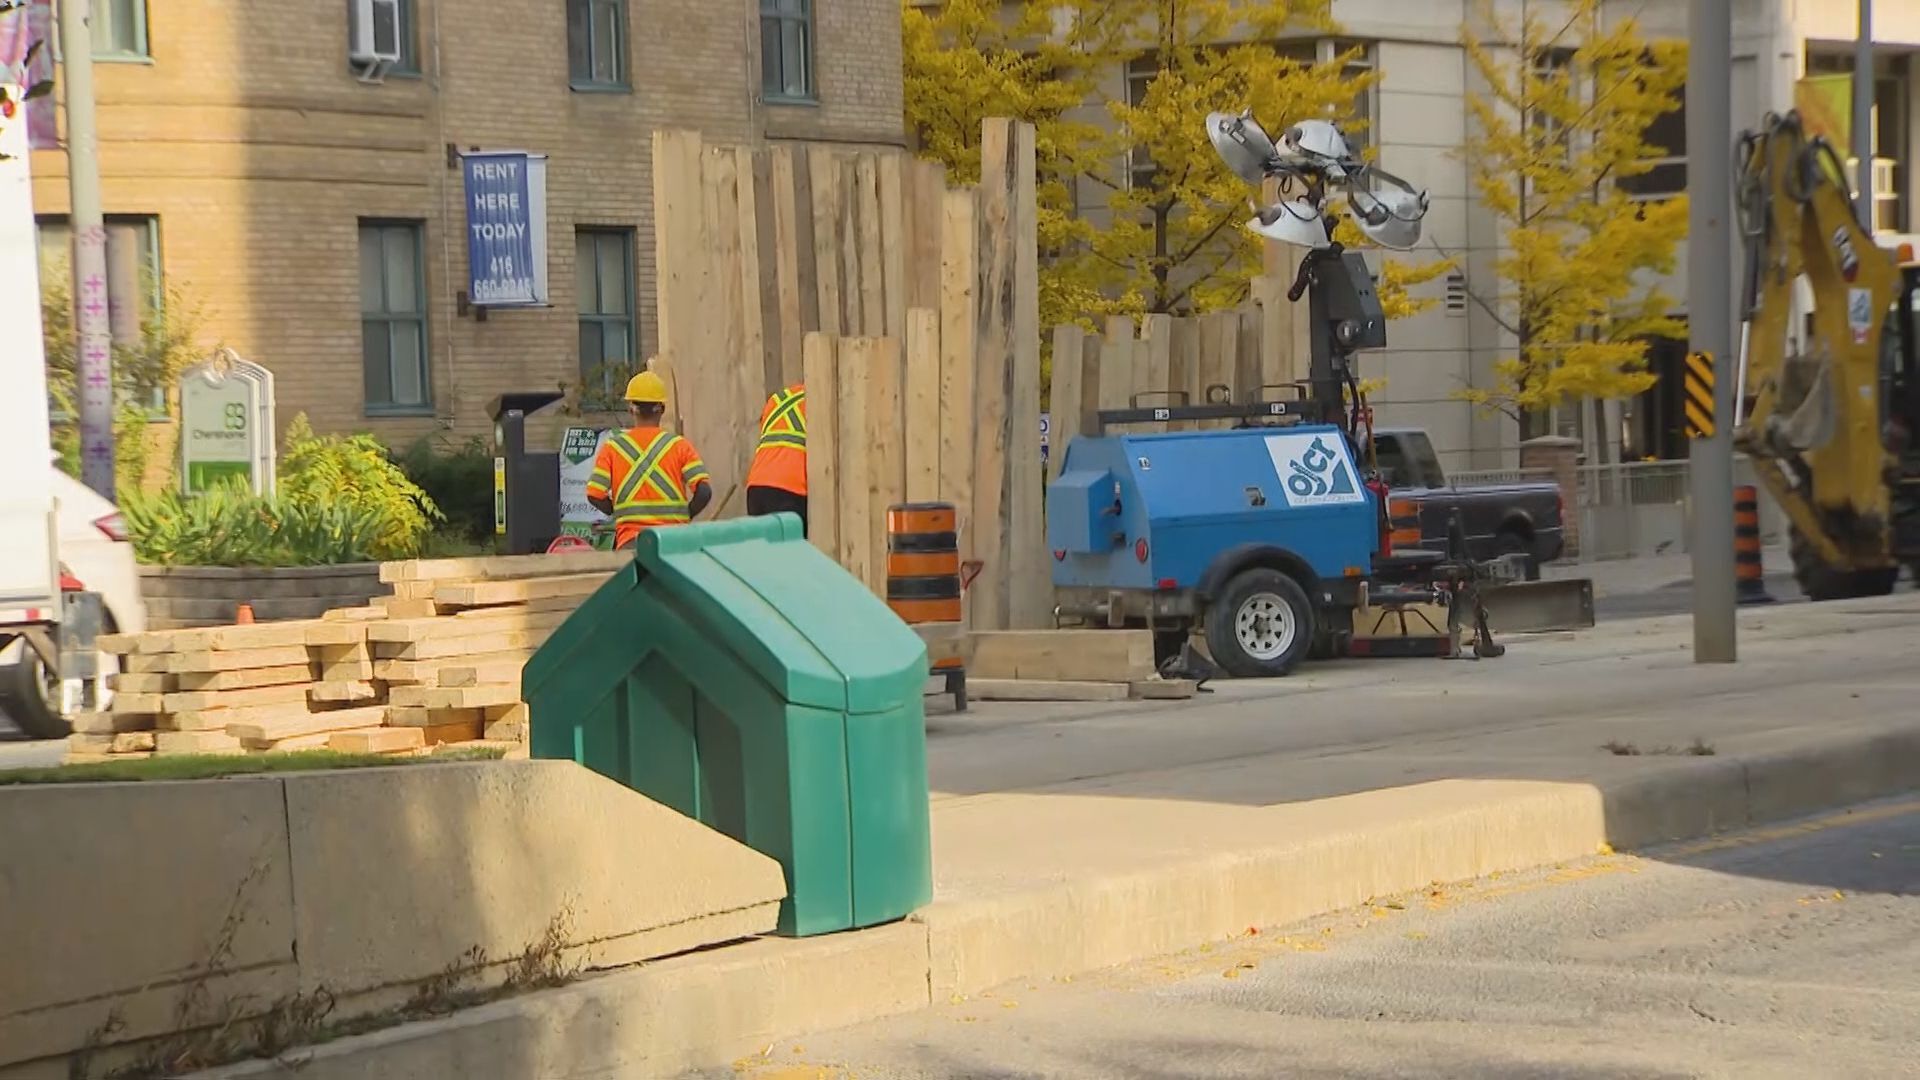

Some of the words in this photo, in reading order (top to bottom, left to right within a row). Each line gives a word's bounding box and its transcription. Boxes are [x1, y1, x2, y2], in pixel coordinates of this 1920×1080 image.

[472, 163, 517, 180] RENT
[475, 193, 520, 210] HERE
[472, 223, 526, 240] TODAY
[490, 256, 513, 276] 416
